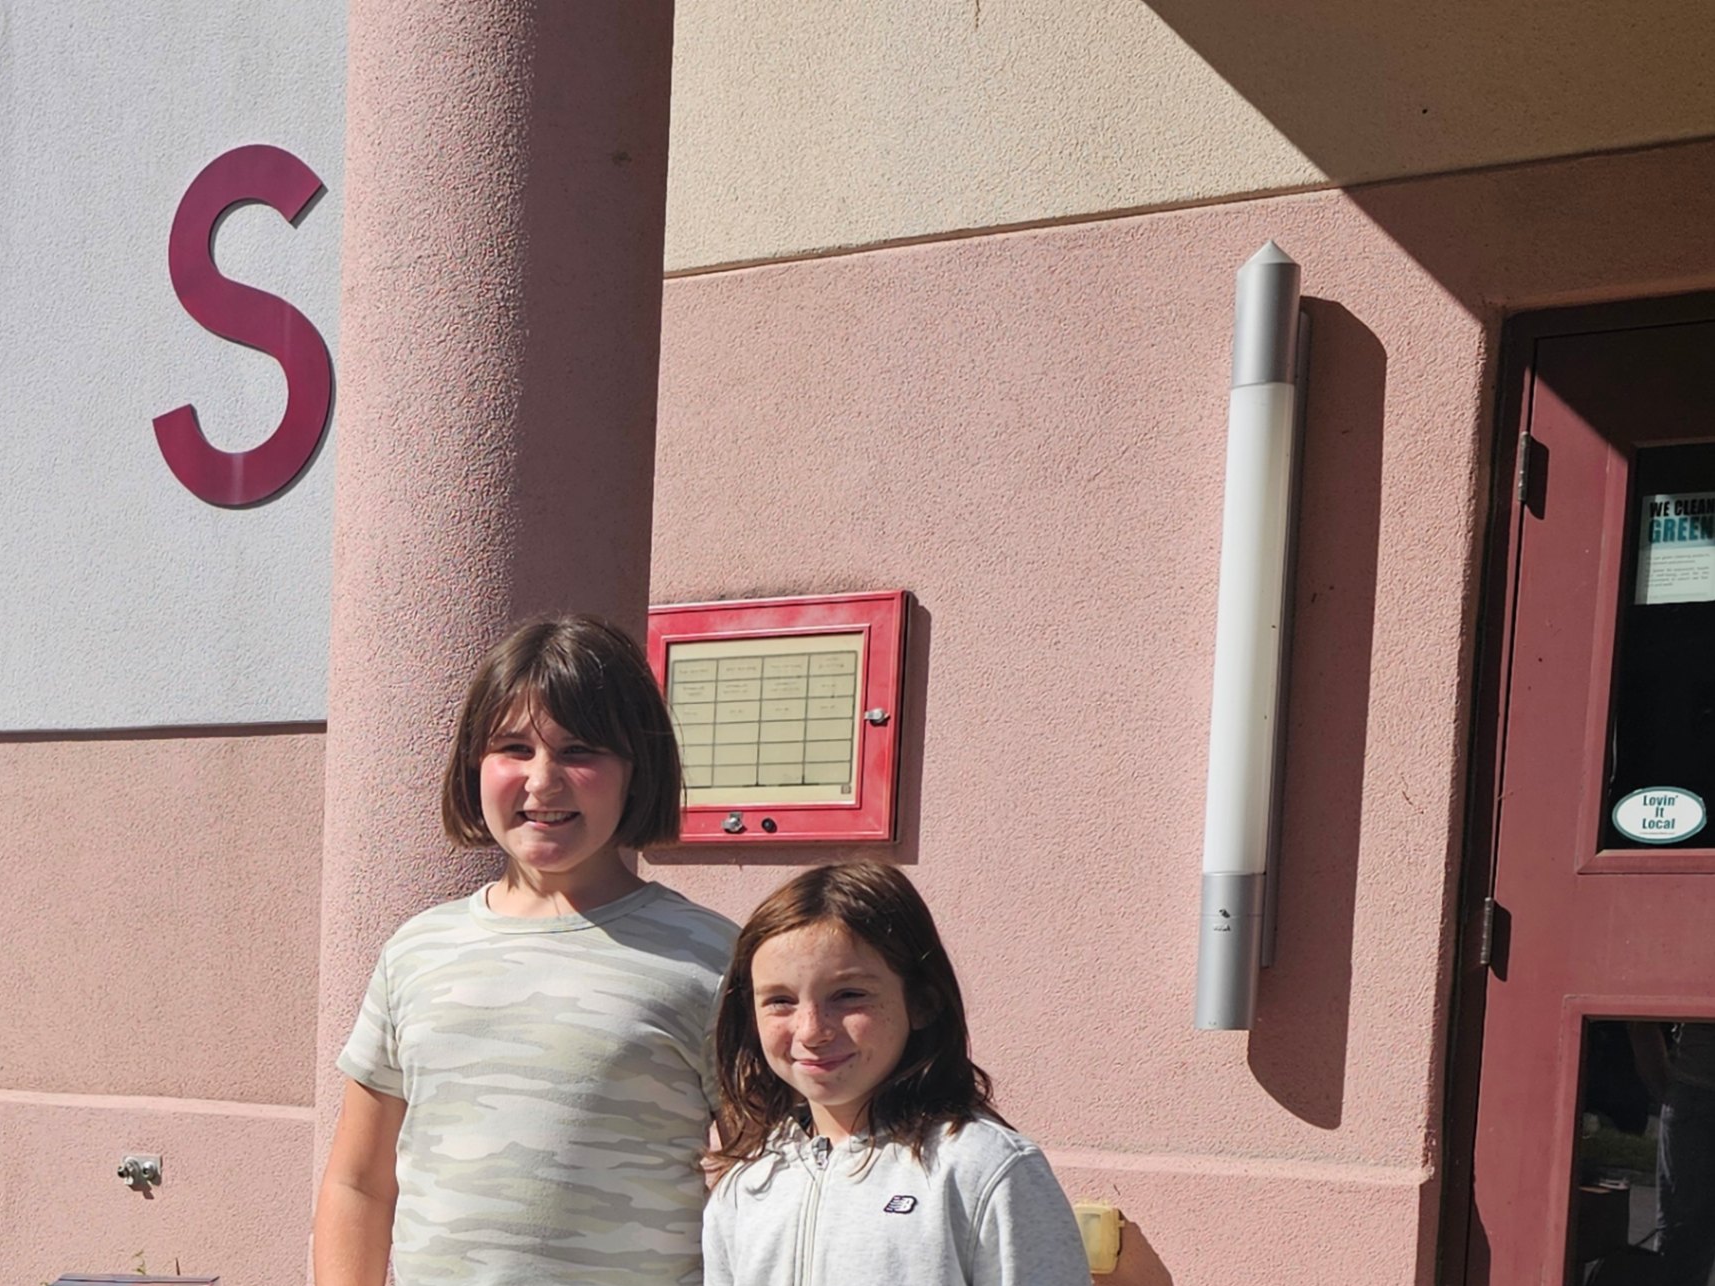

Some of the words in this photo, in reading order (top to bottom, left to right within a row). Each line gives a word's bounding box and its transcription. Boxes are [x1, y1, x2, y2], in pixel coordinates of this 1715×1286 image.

[152, 144, 330, 507] S
[1649, 501, 1670, 518] WE
[1674, 498, 1715, 517] CLEAN
[1649, 516, 1715, 543] GREEN
[1642, 795, 1679, 806] Lovin'
[1642, 818, 1676, 829] Local
